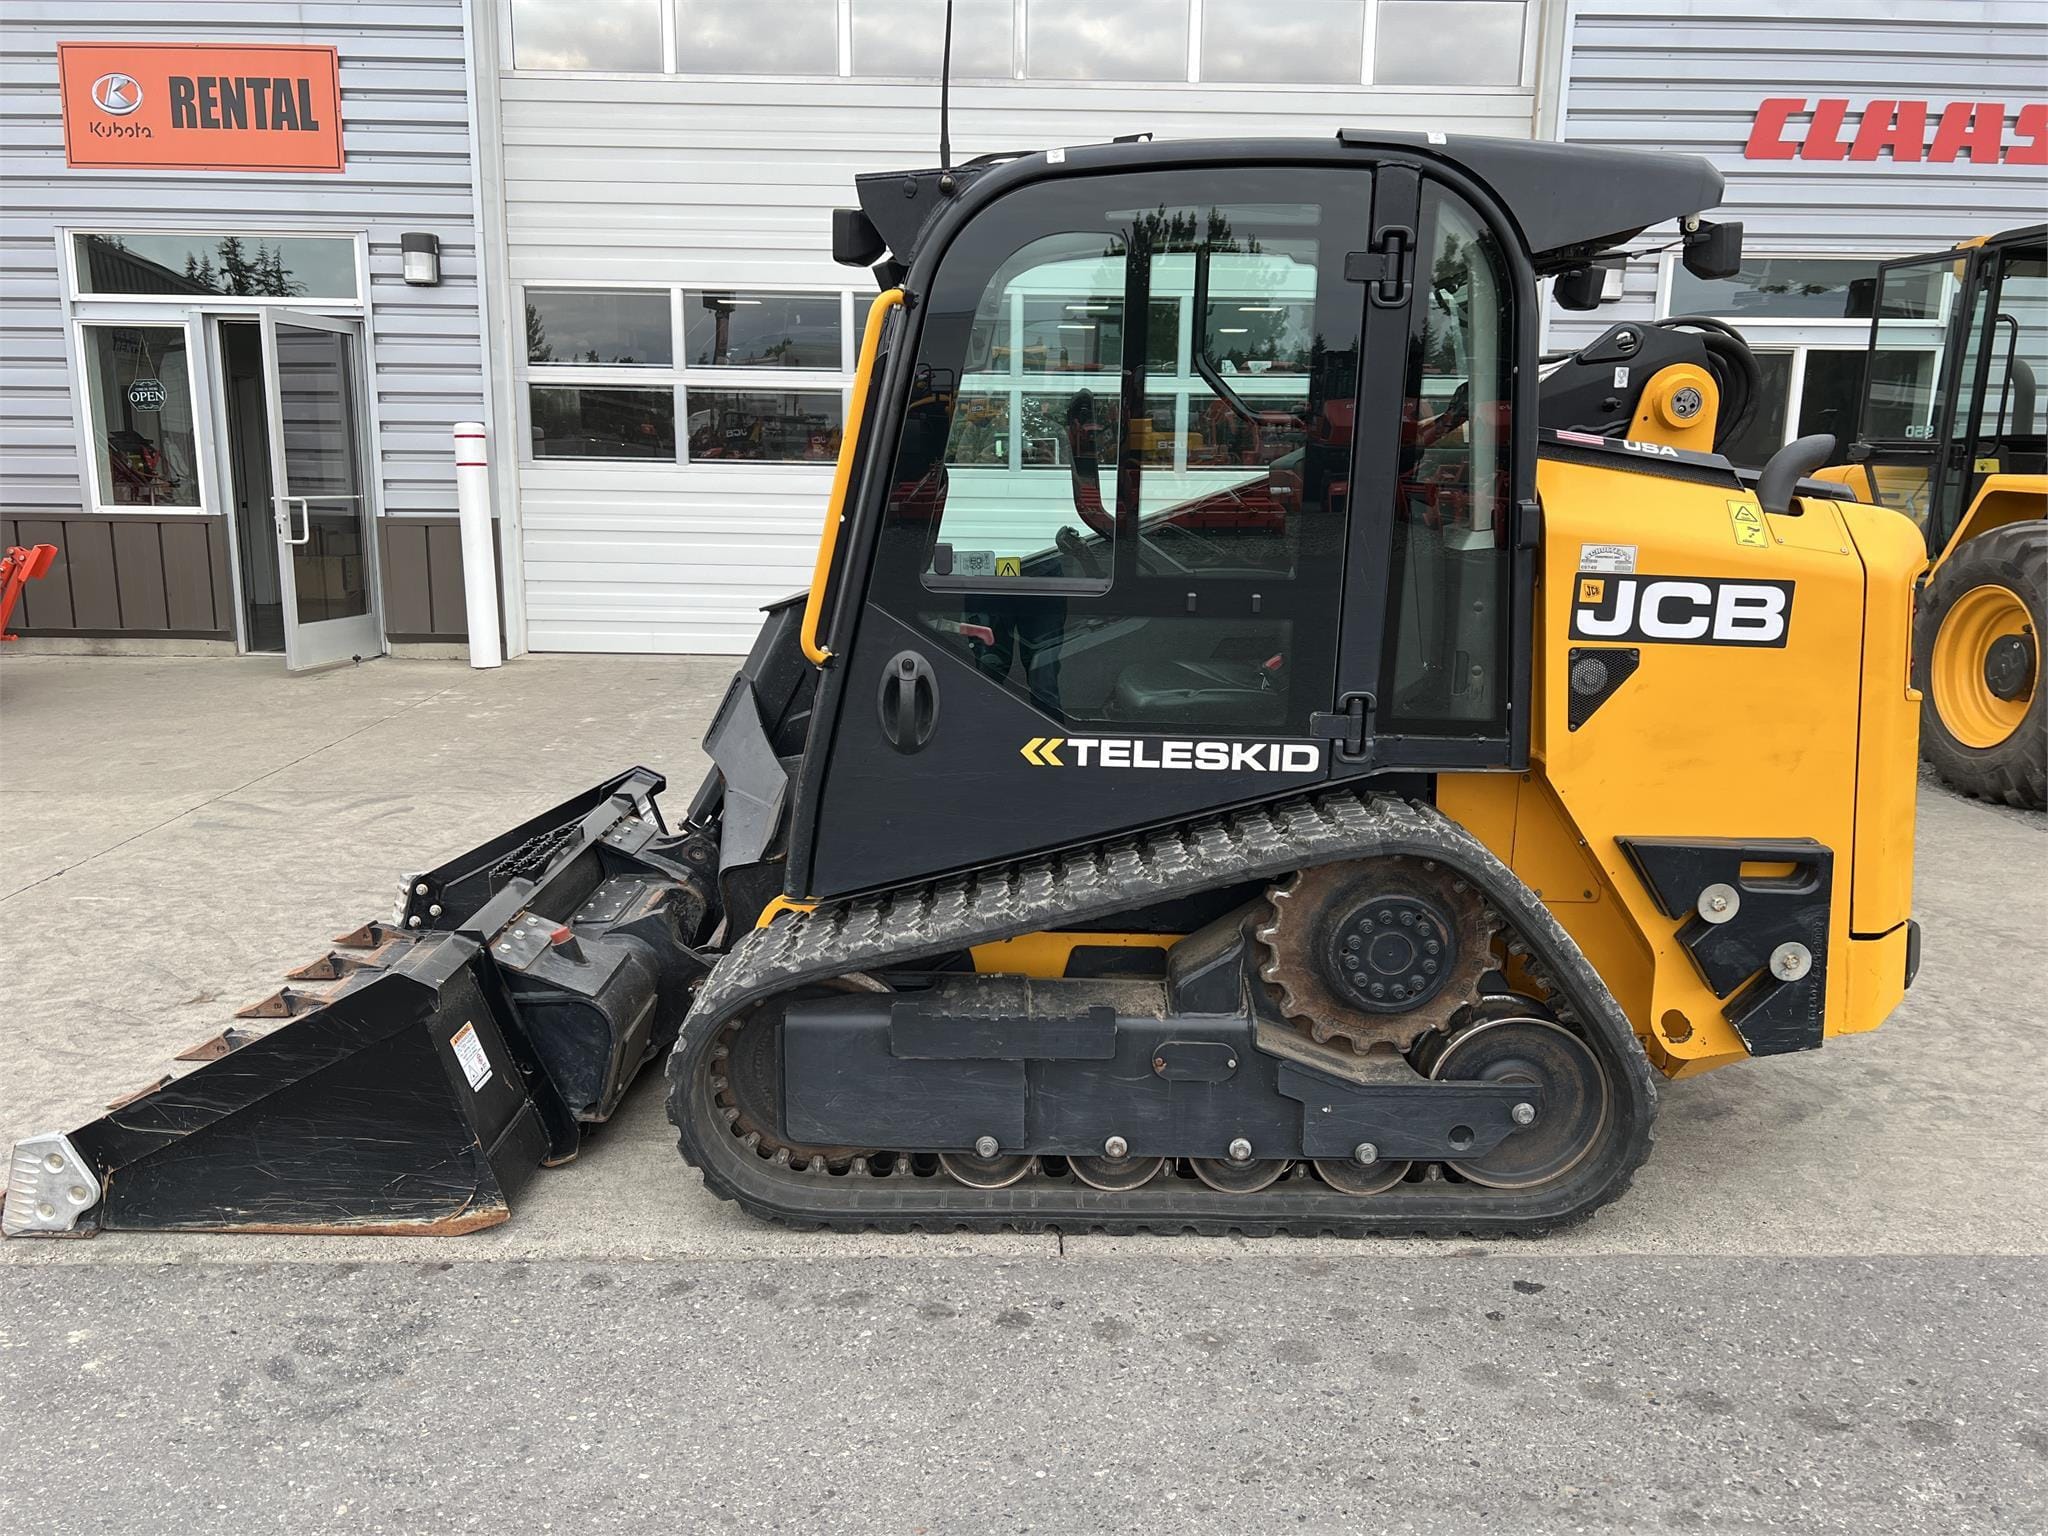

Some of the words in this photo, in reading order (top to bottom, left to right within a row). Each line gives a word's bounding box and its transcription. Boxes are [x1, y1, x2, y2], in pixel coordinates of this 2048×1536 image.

[168, 76, 319, 131] RENTAL
[90, 122, 151, 137] Kubota
[1744, 98, 2048, 165] CLAAS
[130, 391, 165, 402] OPEN
[1623, 440, 1678, 457] USA
[1577, 581, 1786, 641] JCB
[1067, 738, 1319, 773] TELESKID
